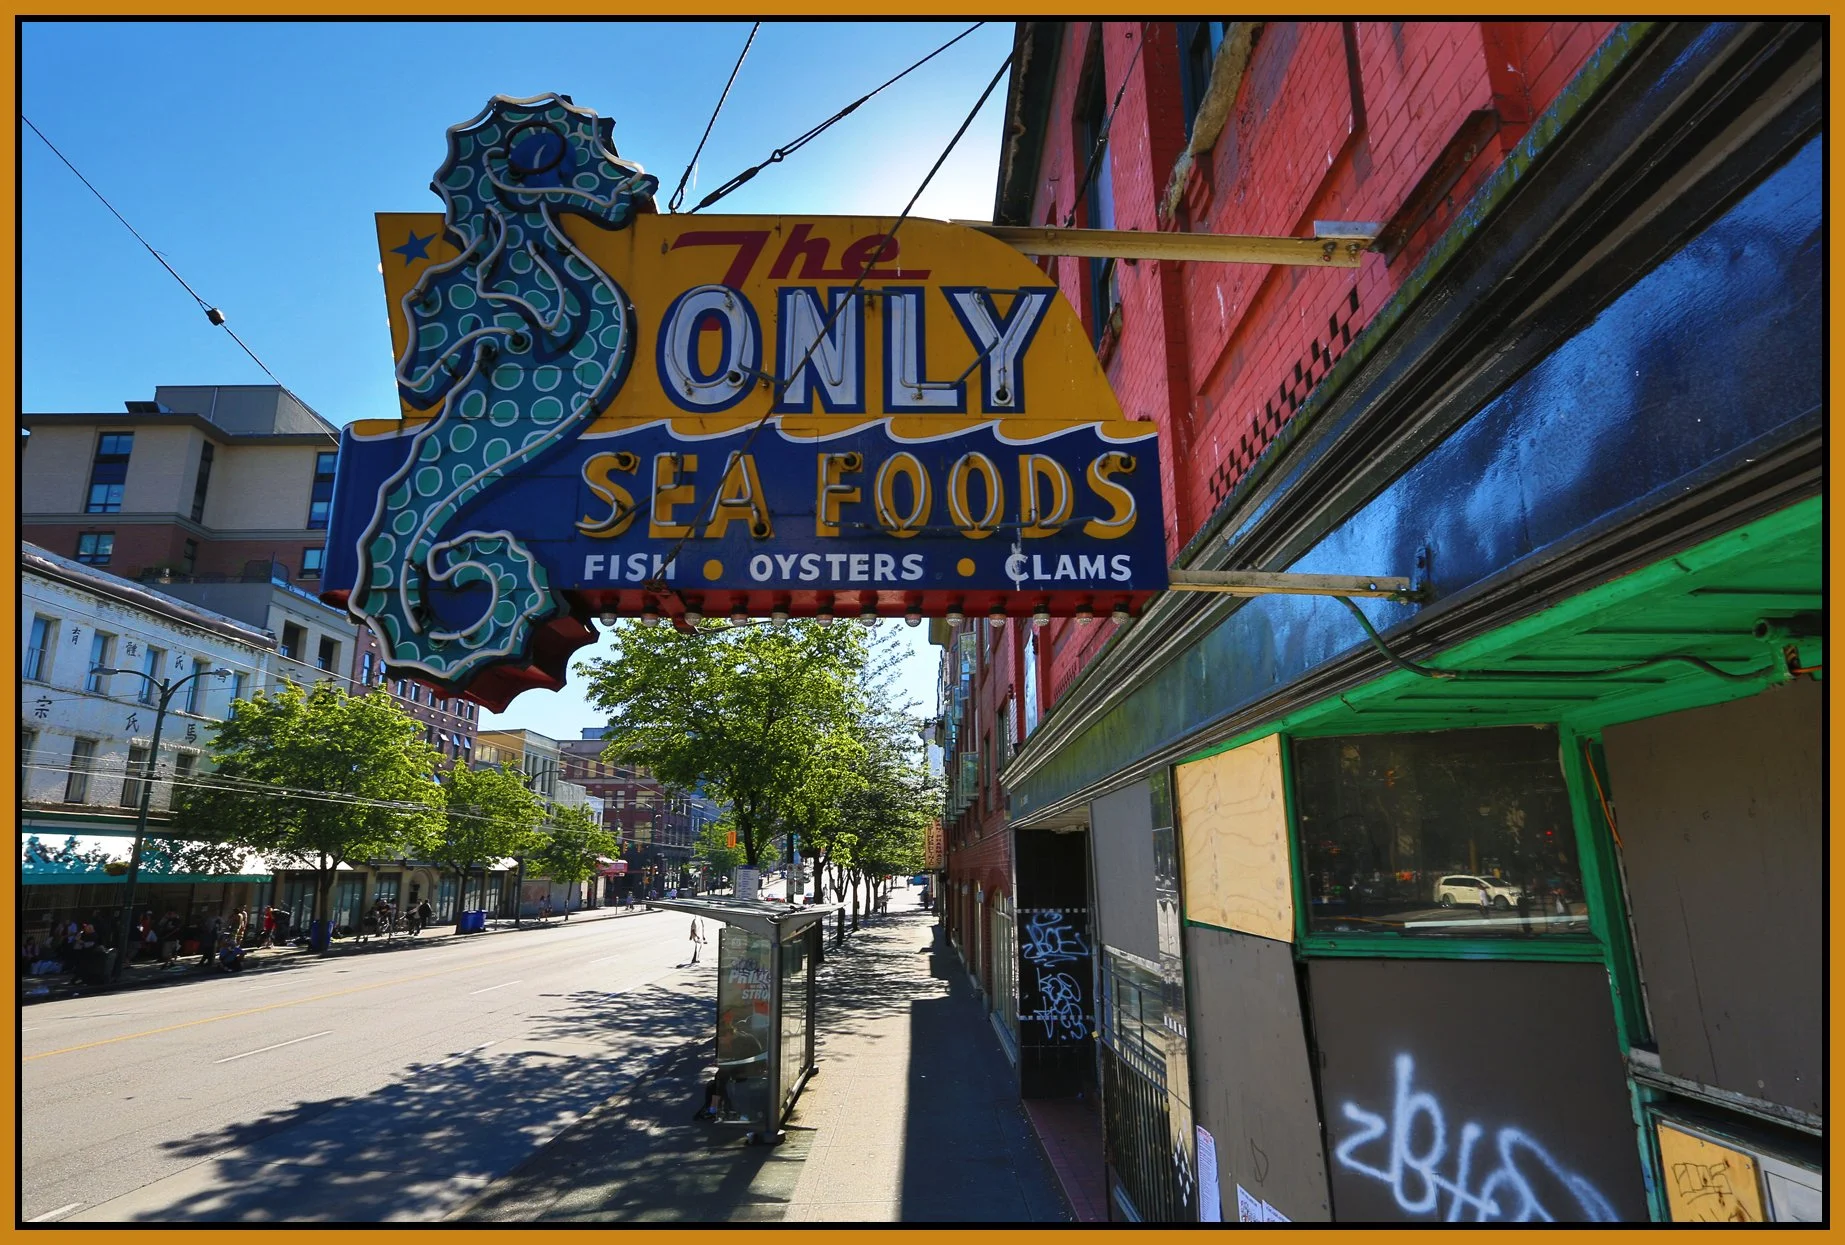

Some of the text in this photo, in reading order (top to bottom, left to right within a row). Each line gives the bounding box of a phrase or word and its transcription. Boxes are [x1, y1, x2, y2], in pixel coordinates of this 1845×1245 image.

[669, 223, 931, 292] The
[656, 284, 1058, 414] ONLY
[576, 450, 1138, 540] SEA FOODS
[583, 552, 1132, 583] FISH OYSTERS CLAMS
[742, 988, 771, 1000] STRO
